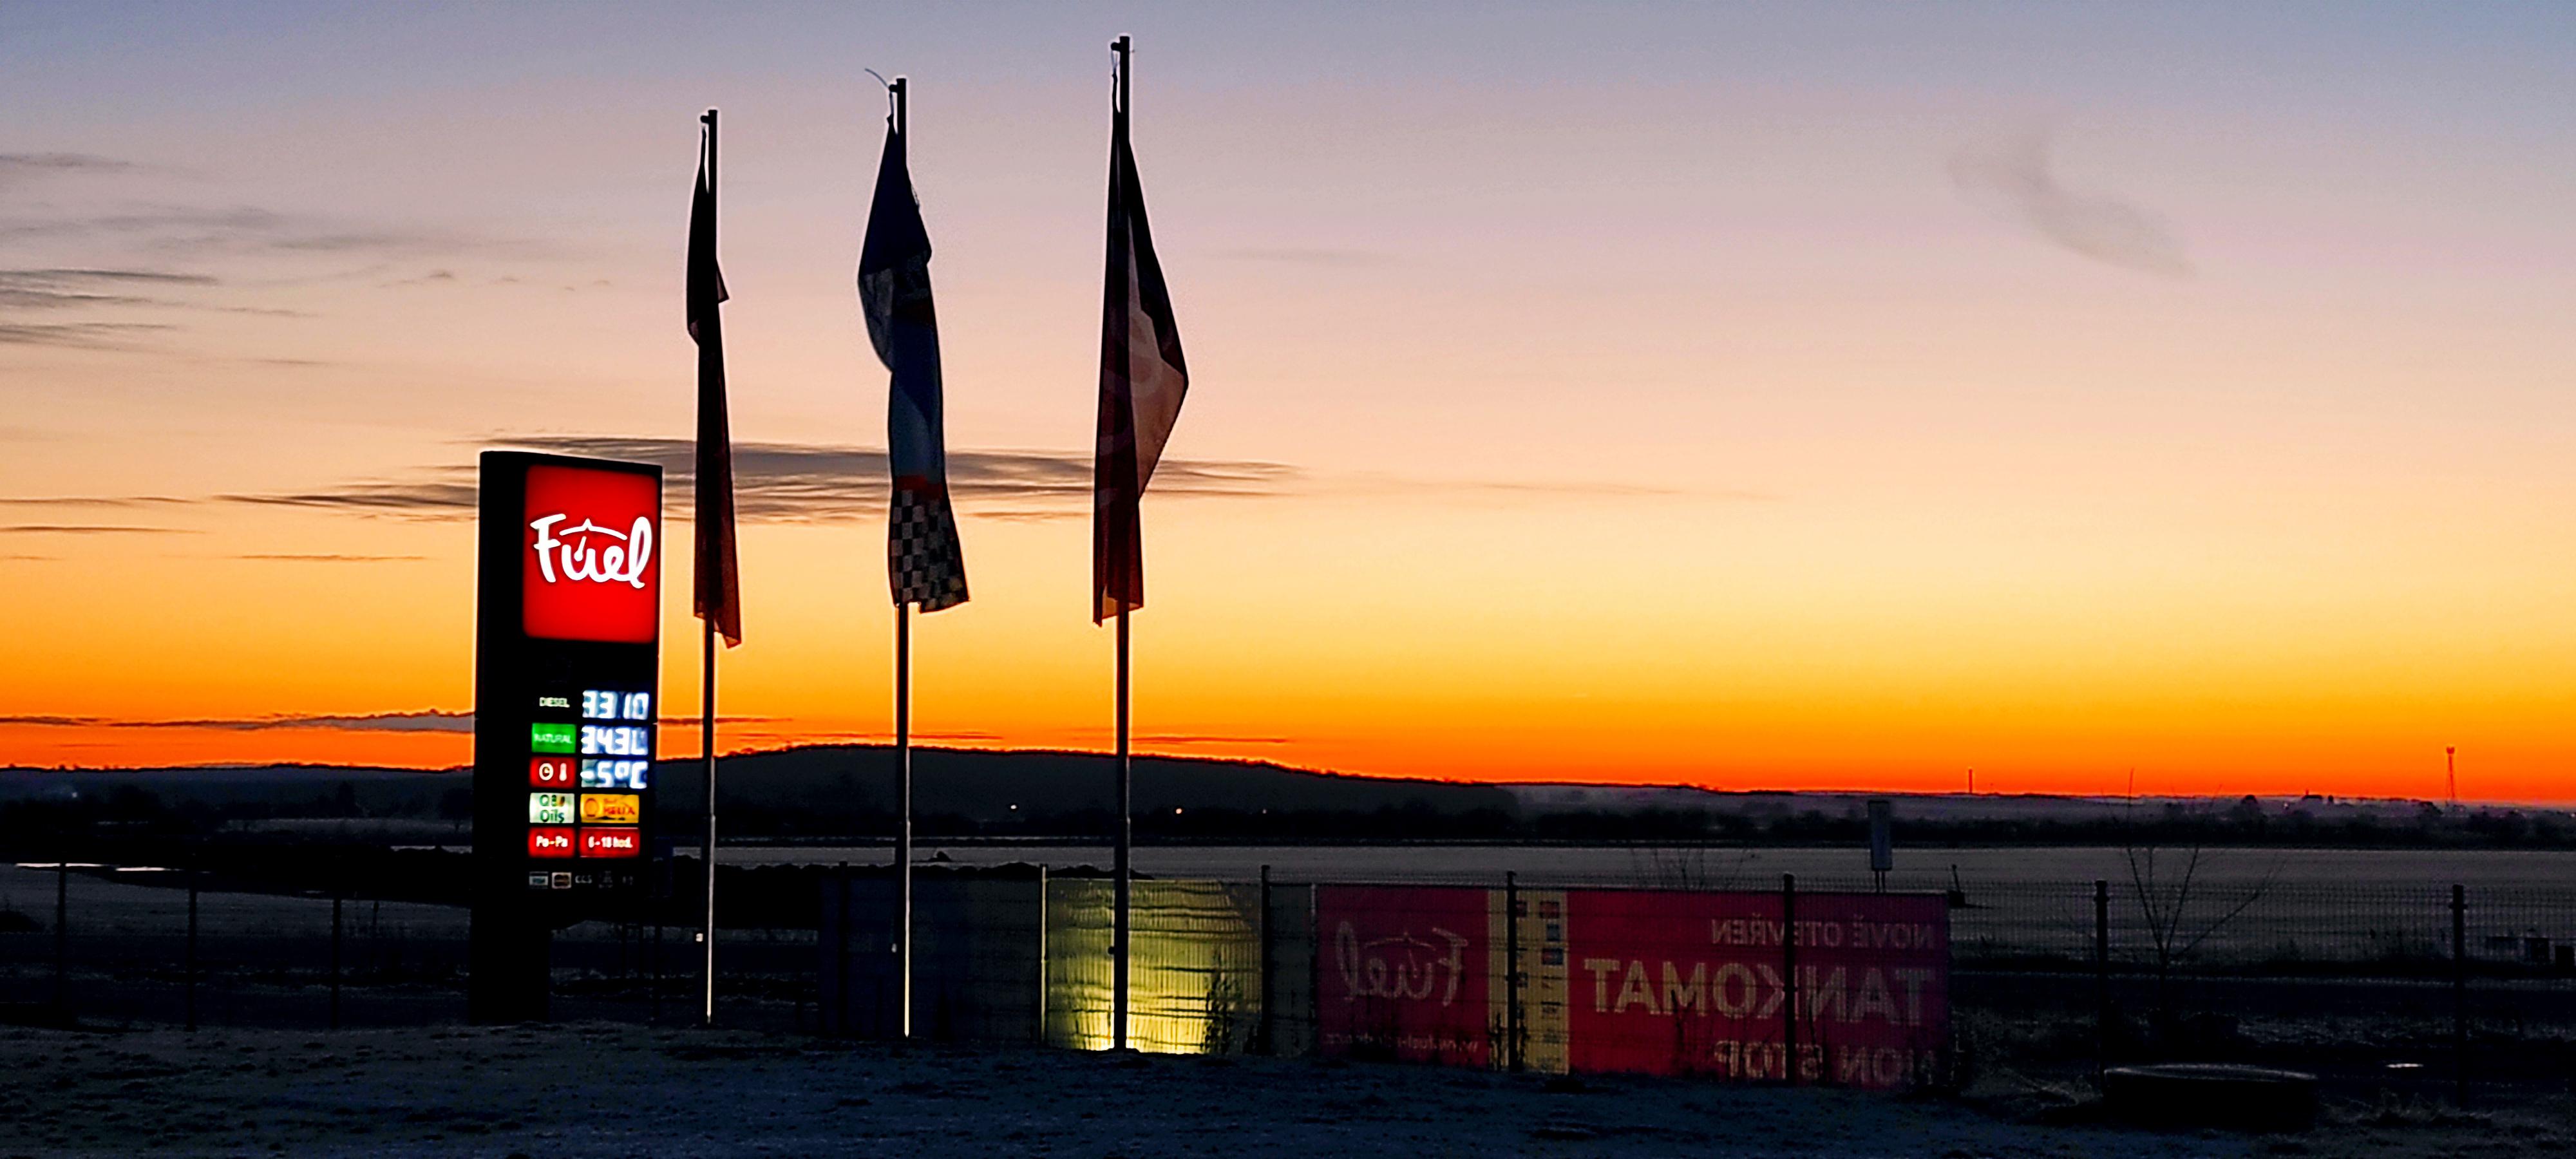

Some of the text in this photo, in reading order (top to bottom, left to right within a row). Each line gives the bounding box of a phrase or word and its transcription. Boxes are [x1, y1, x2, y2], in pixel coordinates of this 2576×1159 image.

[530, 513, 652, 589] Fuel
[533, 733, 573, 744] NATURAL
[540, 809, 565, 823] Oils
